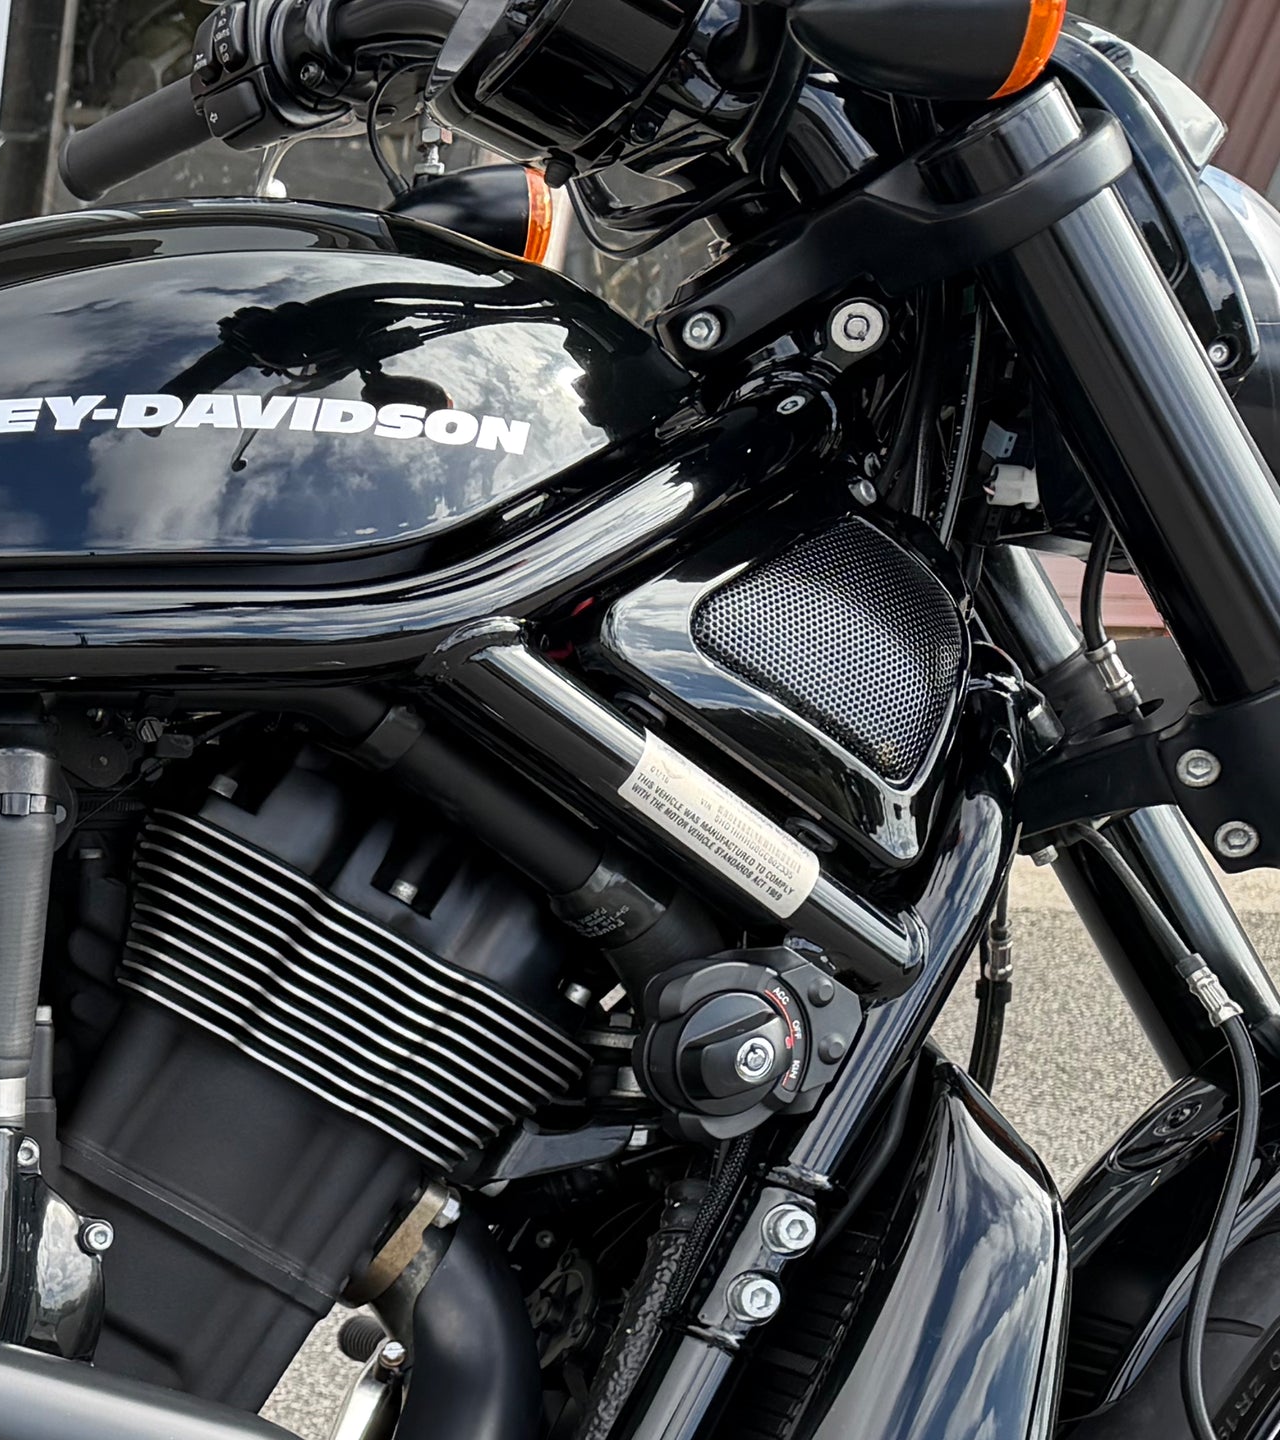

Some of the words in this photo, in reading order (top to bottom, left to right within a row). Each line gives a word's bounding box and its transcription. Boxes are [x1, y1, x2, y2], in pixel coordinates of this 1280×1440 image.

[629, 781, 652, 801] WITH
[648, 795, 666, 812] THE
[662, 806, 689, 830] MOTOR
[685, 824, 716, 851] VEHICLE
[711, 844, 754, 880] STANDARDS
[750, 874, 767, 889] ACT
[635, 771, 656, 790] THIS
[652, 784, 685, 812] VEHICLE
[681, 806, 701, 825] WAS
[698, 819, 756, 867] MANUFACTURED
[753, 861, 767, 875] TO
[763, 869, 795, 897] COMPLY
[772, 986, 790, 1005] ACC
[791, 1019, 802, 1039] OFF
